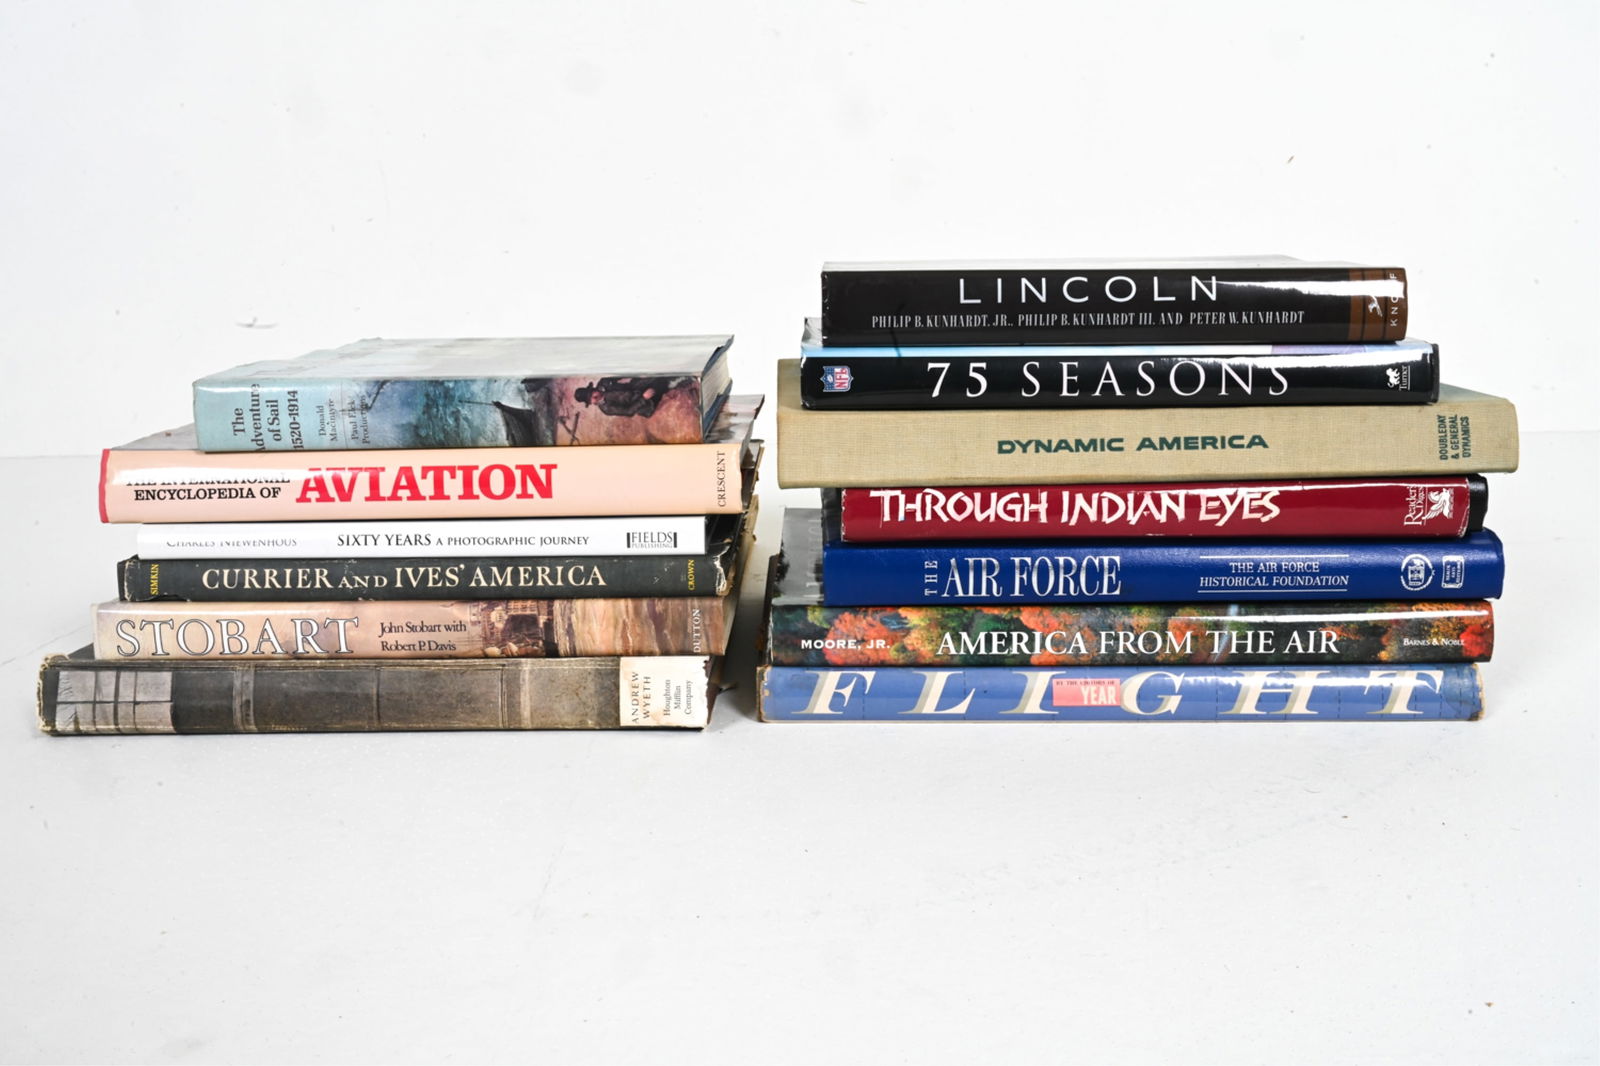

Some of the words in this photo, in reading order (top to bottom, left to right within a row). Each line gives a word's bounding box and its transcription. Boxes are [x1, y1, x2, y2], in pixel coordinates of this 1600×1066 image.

[959, 275, 1217, 304] LINCOLN
[1389, 273, 1399, 327] KNOF
[872, 315, 912, 328] PHILIP
[914, 315, 924, 328] B.
[1018, 313, 1058, 327] PHILIP
[1061, 313, 1070, 326] B.
[1073, 312, 1136, 326] KUNHARDT
[1159, 312, 1183, 325] AND
[1190, 311, 1226, 325] PETER
[1229, 311, 1239, 324] W.
[1241, 311, 1305, 324] KUNHARDT
[835, 368, 848, 388] NFL
[926, 362, 988, 398] 75
[1020, 360, 1288, 398] SEASONS
[1398, 365, 1408, 391] Turner
[231, 408, 246, 436] The
[265, 400, 280, 426] Sail
[287, 390, 304, 450] 1520-1914
[316, 405, 327, 436] Donald
[267, 427, 282, 442] of
[349, 421, 359, 440] Paul
[997, 437, 1125, 454] DYNAMIC
[1136, 434, 1269, 451] AMERICA
[1437, 414, 1449, 461] DOUBLEDAY
[1450, 414, 1460, 451] GENERAL
[1461, 416, 1472, 458] DYNAMICS
[1451, 452, 1460, 460] &
[295, 464, 558, 503] AVIATION
[715, 451, 727, 508] CRESCENT
[134, 488, 256, 501] ENCYCLOPEDIA
[260, 487, 281, 498] OF
[870, 488, 1049, 526] THROUGH
[1061, 490, 1186, 526] INDIAN
[1199, 488, 1281, 527] EYES
[1415, 484, 1425, 508] Diges
[337, 534, 380, 546] SIXTY
[385, 534, 432, 546] YEARS
[436, 537, 443, 546] A
[447, 536, 536, 546] PHOTOGRAPHIC
[540, 536, 589, 547] JOURNEY
[631, 531, 673, 543] FIELDS
[150, 564, 159, 595] SIMKIN
[202, 567, 334, 590] CURRIER
[337, 570, 388, 588] AND
[469, 563, 607, 588] AMERICA
[687, 559, 696, 591] CROWN
[924, 560, 938, 596] THE
[941, 556, 1004, 597] AIR
[1010, 556, 1122, 597] FORCE
[1200, 576, 1269, 588] HISTORICAL
[1272, 575, 1349, 587] FOUNDATION
[1229, 562, 1254, 573] THE
[1257, 562, 1277, 573] AIR
[1281, 562, 1320, 573] FORCE
[116, 616, 360, 657] STOBART
[378, 621, 404, 638] John
[405, 620, 441, 633] Stobart
[443, 620, 467, 632] with
[692, 608, 701, 653] DUTTON
[936, 630, 1088, 656] AMERICA
[1099, 630, 1194, 655] FROM
[1204, 629, 1276, 654] THE
[1284, 629, 1340, 654] AIR
[1432, 638, 1439, 646] &
[381, 640, 416, 651] Robert
[418, 640, 426, 651] P.
[428, 640, 457, 651] Davis
[801, 639, 863, 651] MOORE,
[866, 638, 890, 650] JR.
[631, 671, 640, 724] ANDREW
[643, 676, 651, 719] WYETH
[663, 679, 672, 716] Houghton
[674, 685, 682, 710] Mifflin
[684, 680, 694, 715] Company
[791, 669, 1444, 716] FLIGHT
[1080, 685, 1117, 705] YEAR
